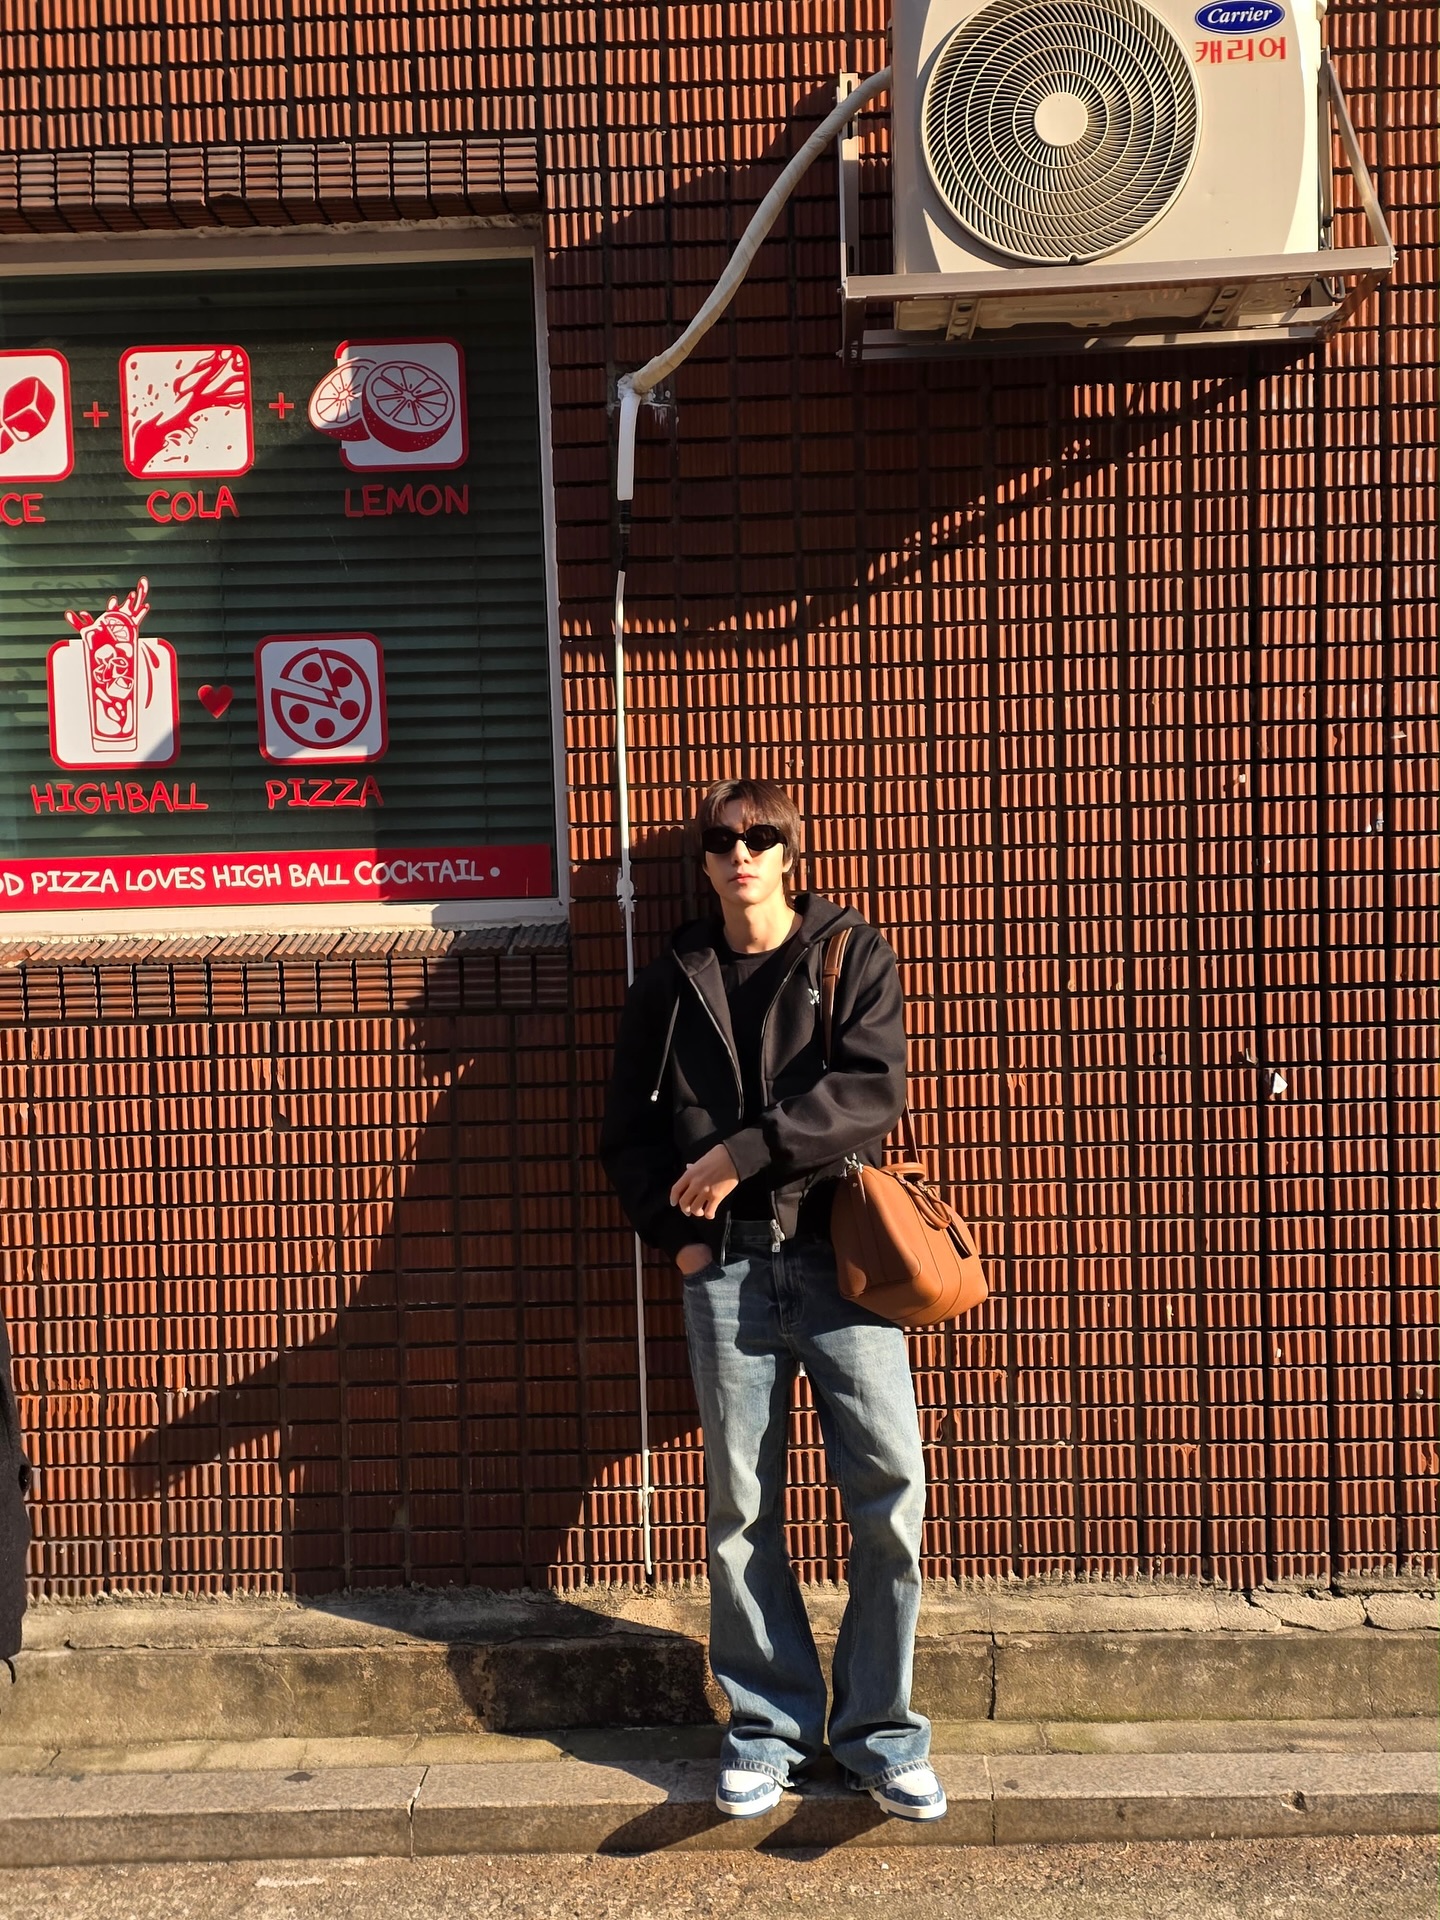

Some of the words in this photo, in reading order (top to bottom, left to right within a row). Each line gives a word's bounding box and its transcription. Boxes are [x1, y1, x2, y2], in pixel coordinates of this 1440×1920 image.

[1207, 7, 1273, 24] Carrier
[1195, 36, 1286, 63] 캐리어
[146, 485, 240, 523] COLA
[344, 483, 469, 517] LEMON
[30, 780, 209, 814] HIGHBALL
[265, 775, 384, 809] PIZZA
[31, 868, 119, 895] PIZZA
[125, 866, 206, 891] LOVES
[212, 863, 282, 889] HIGH
[289, 862, 350, 888] BALL
[354, 859, 484, 885] COCKTAIL
